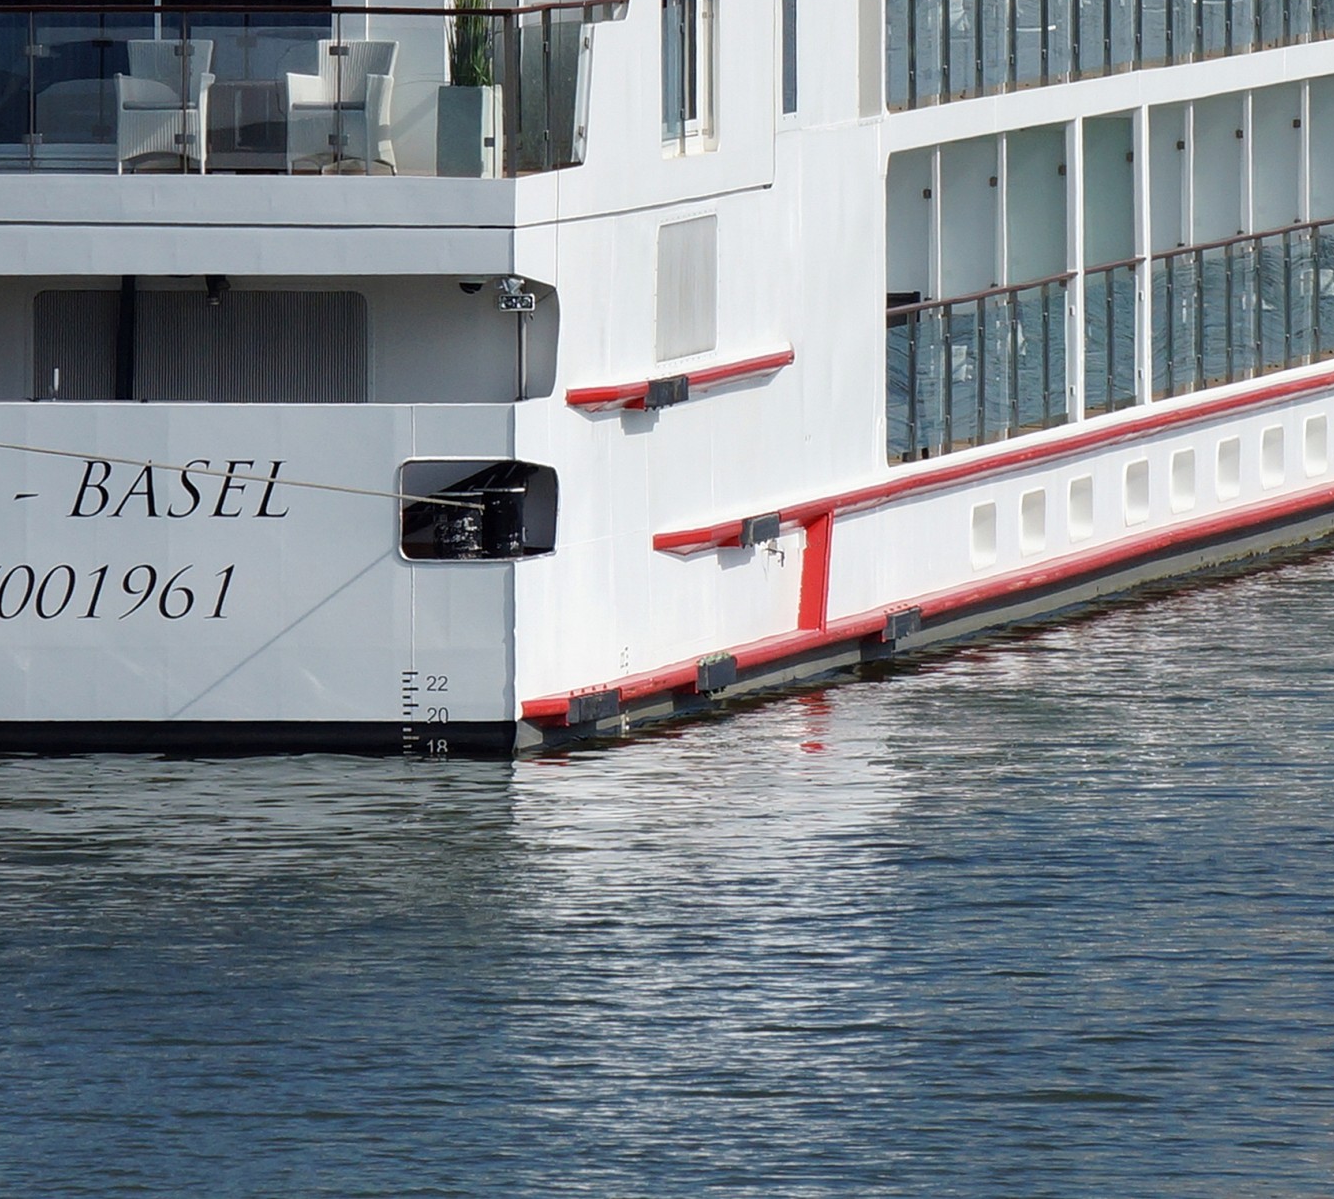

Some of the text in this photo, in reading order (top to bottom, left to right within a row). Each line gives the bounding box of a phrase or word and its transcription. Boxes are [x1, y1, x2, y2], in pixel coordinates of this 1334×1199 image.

[68, 458, 291, 520] BASEL
[426, 675, 449, 691] 22
[426, 706, 450, 724] 20
[426, 738, 449, 754] 18
